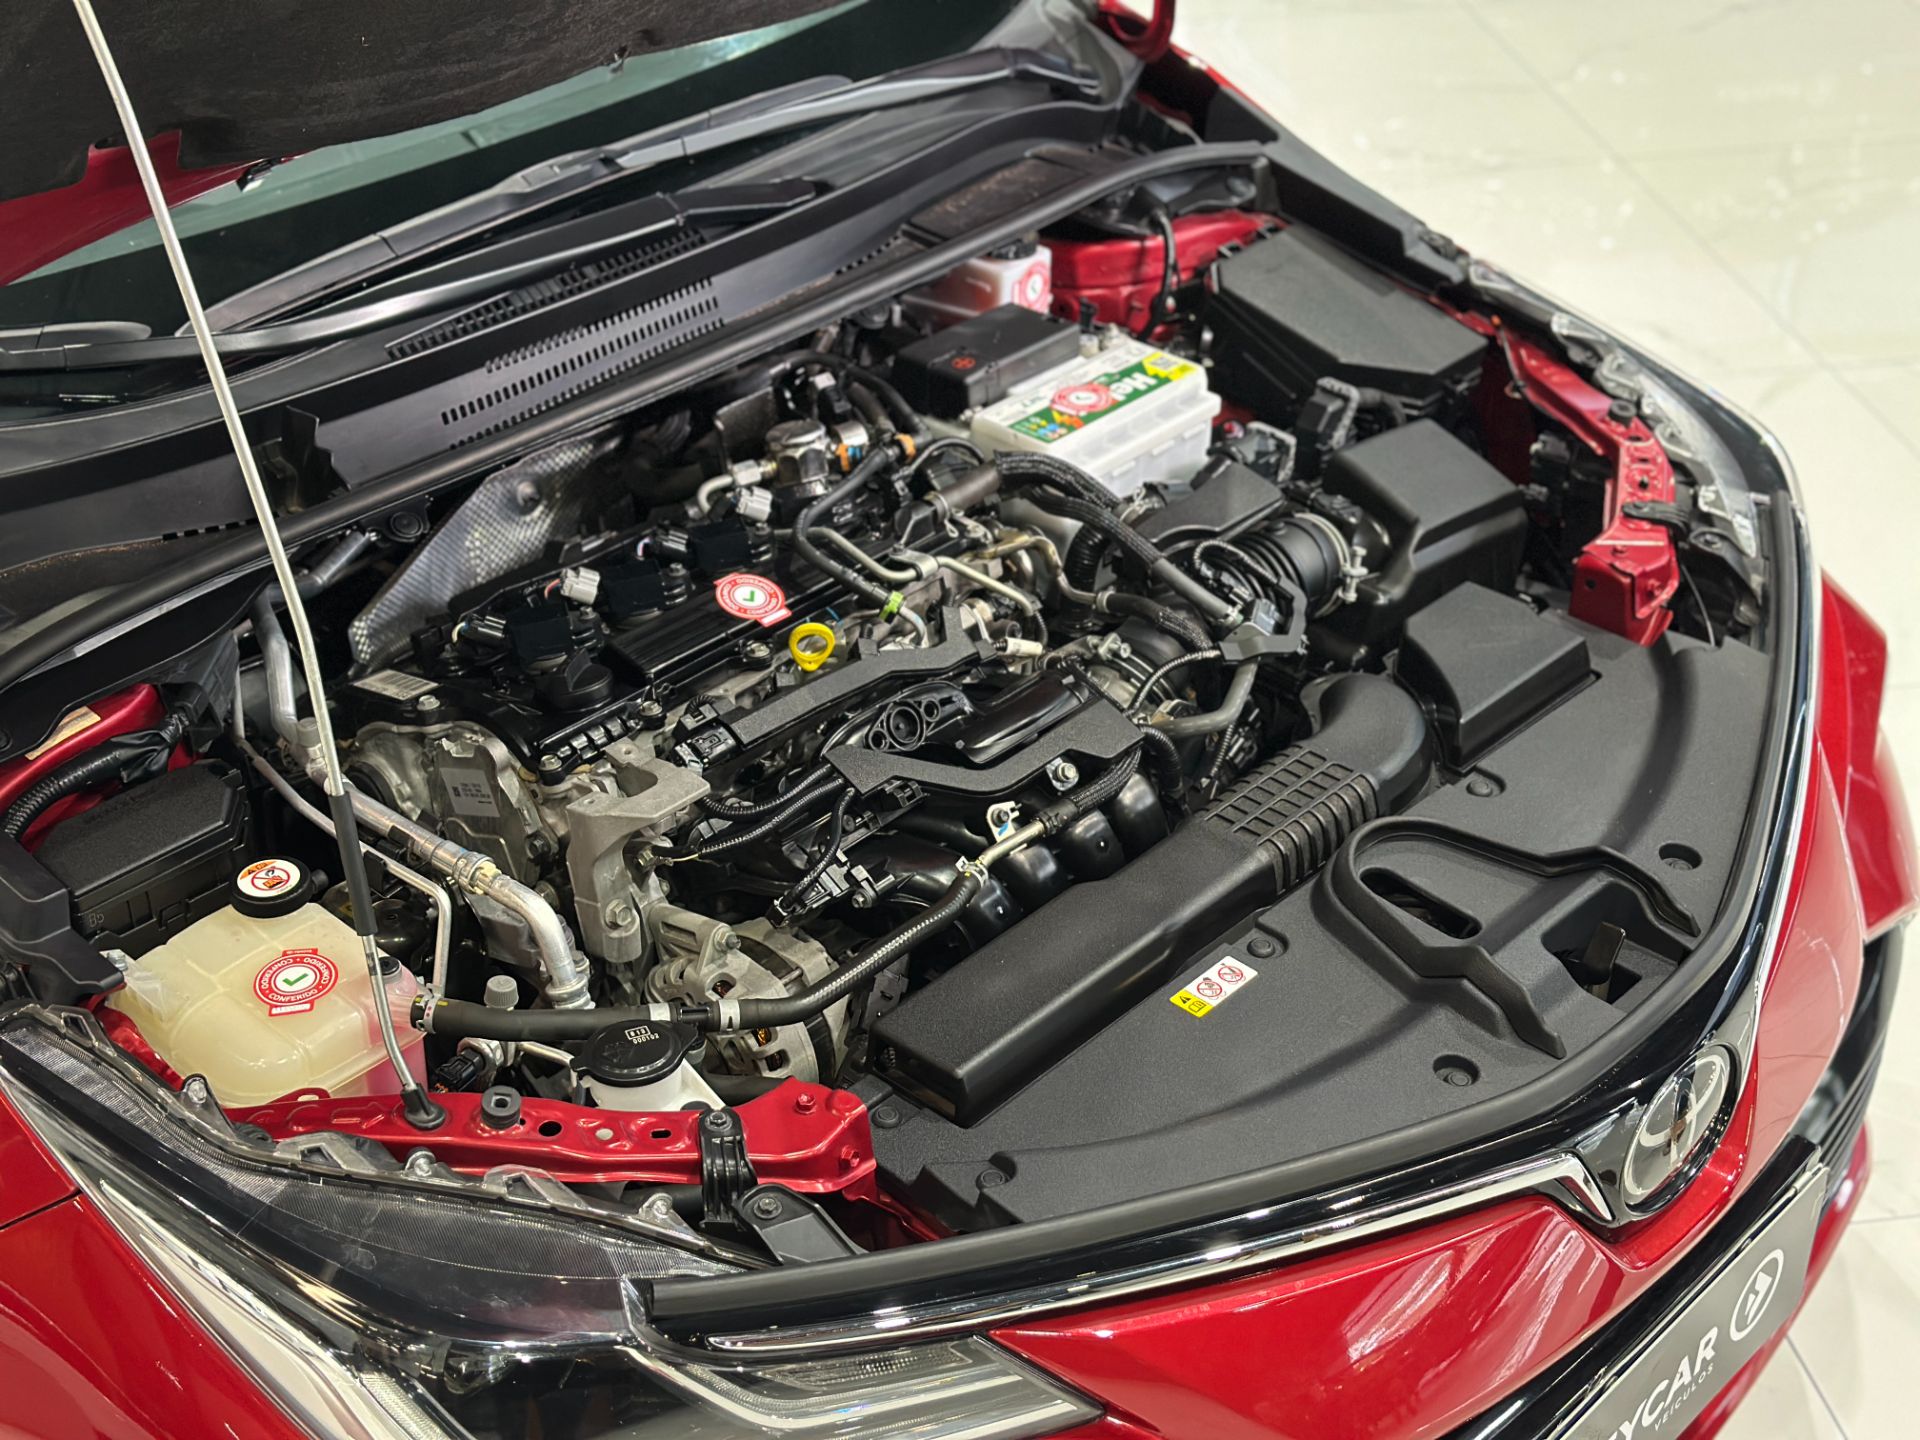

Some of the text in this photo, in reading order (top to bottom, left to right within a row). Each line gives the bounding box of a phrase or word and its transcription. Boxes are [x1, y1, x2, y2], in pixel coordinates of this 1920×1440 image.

[260, 958, 293, 990] CONFERIDO
[303, 957, 330, 984] CONFERIDO
[268, 989, 318, 1002] CONFERIDO
